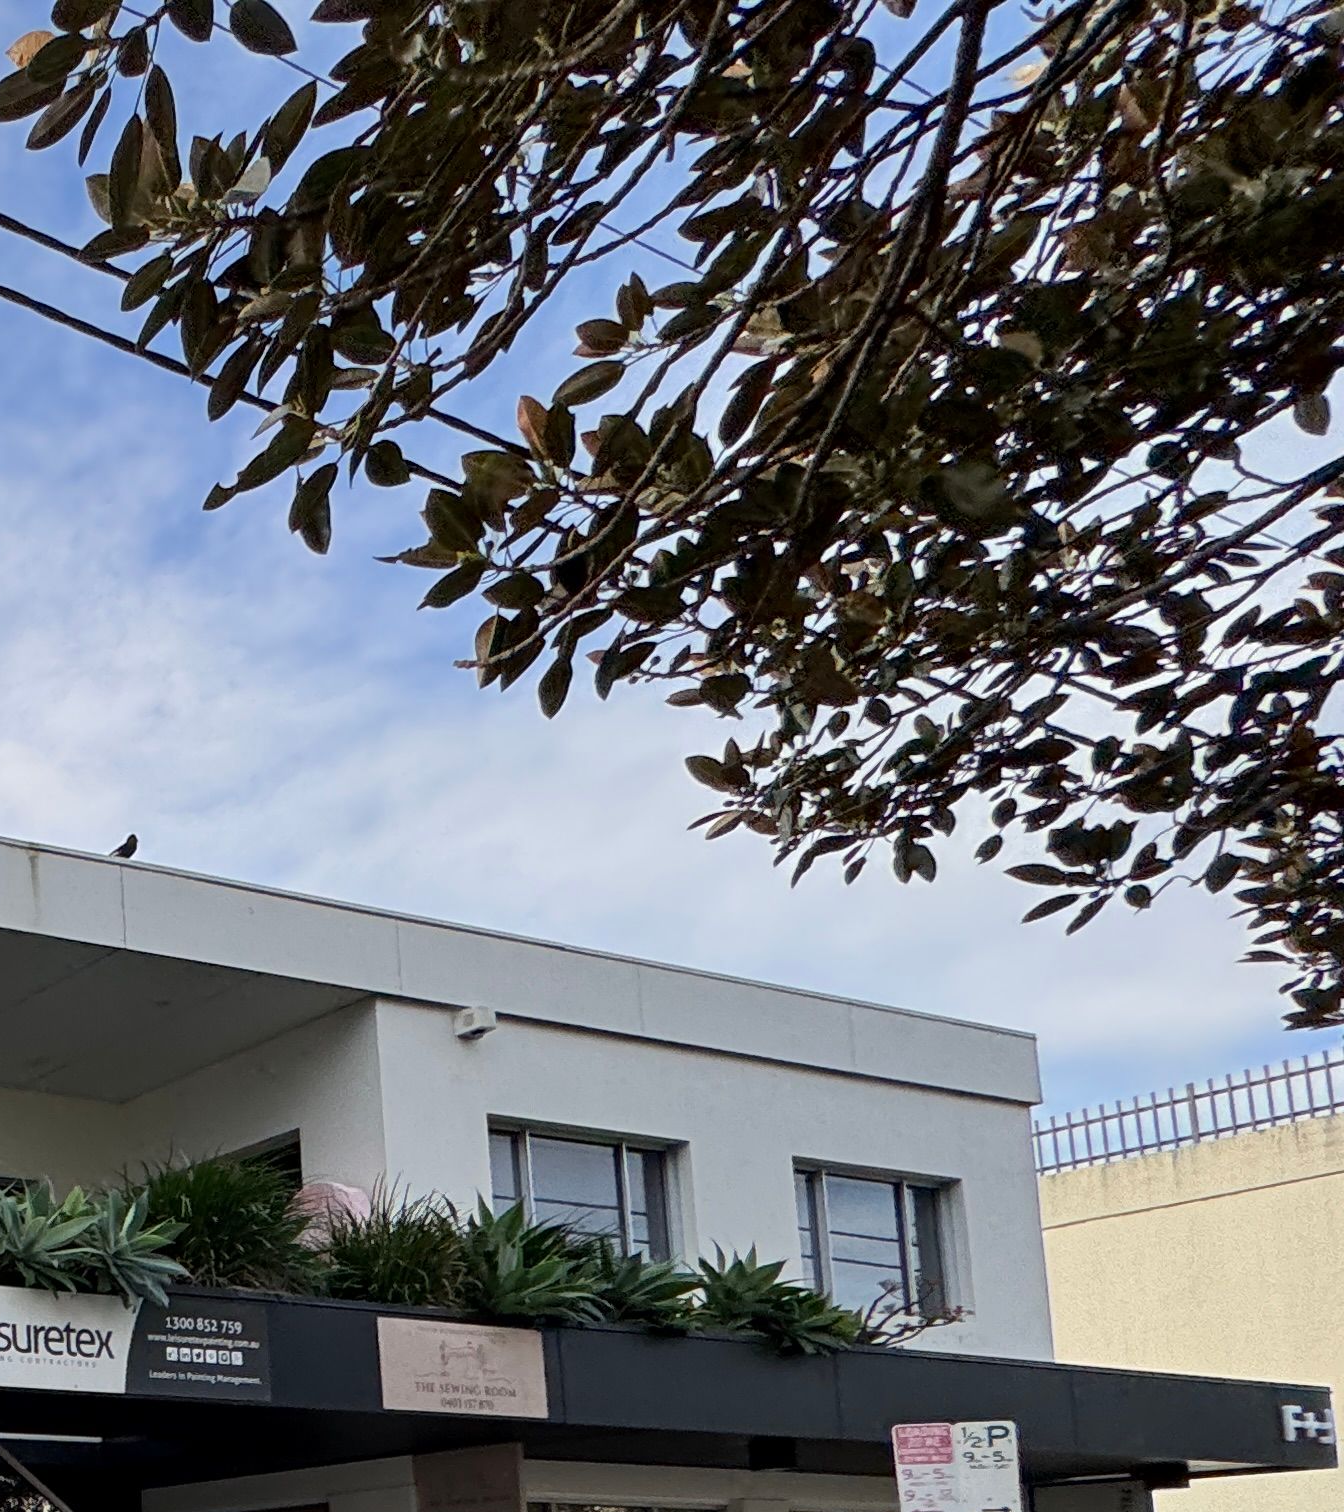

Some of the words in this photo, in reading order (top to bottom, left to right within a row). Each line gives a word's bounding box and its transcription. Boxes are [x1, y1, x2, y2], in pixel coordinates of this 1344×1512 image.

[165, 1316, 194, 1330] 1300
[196, 1318, 218, 1332] 852
[220, 1320, 243, 1335] 759
